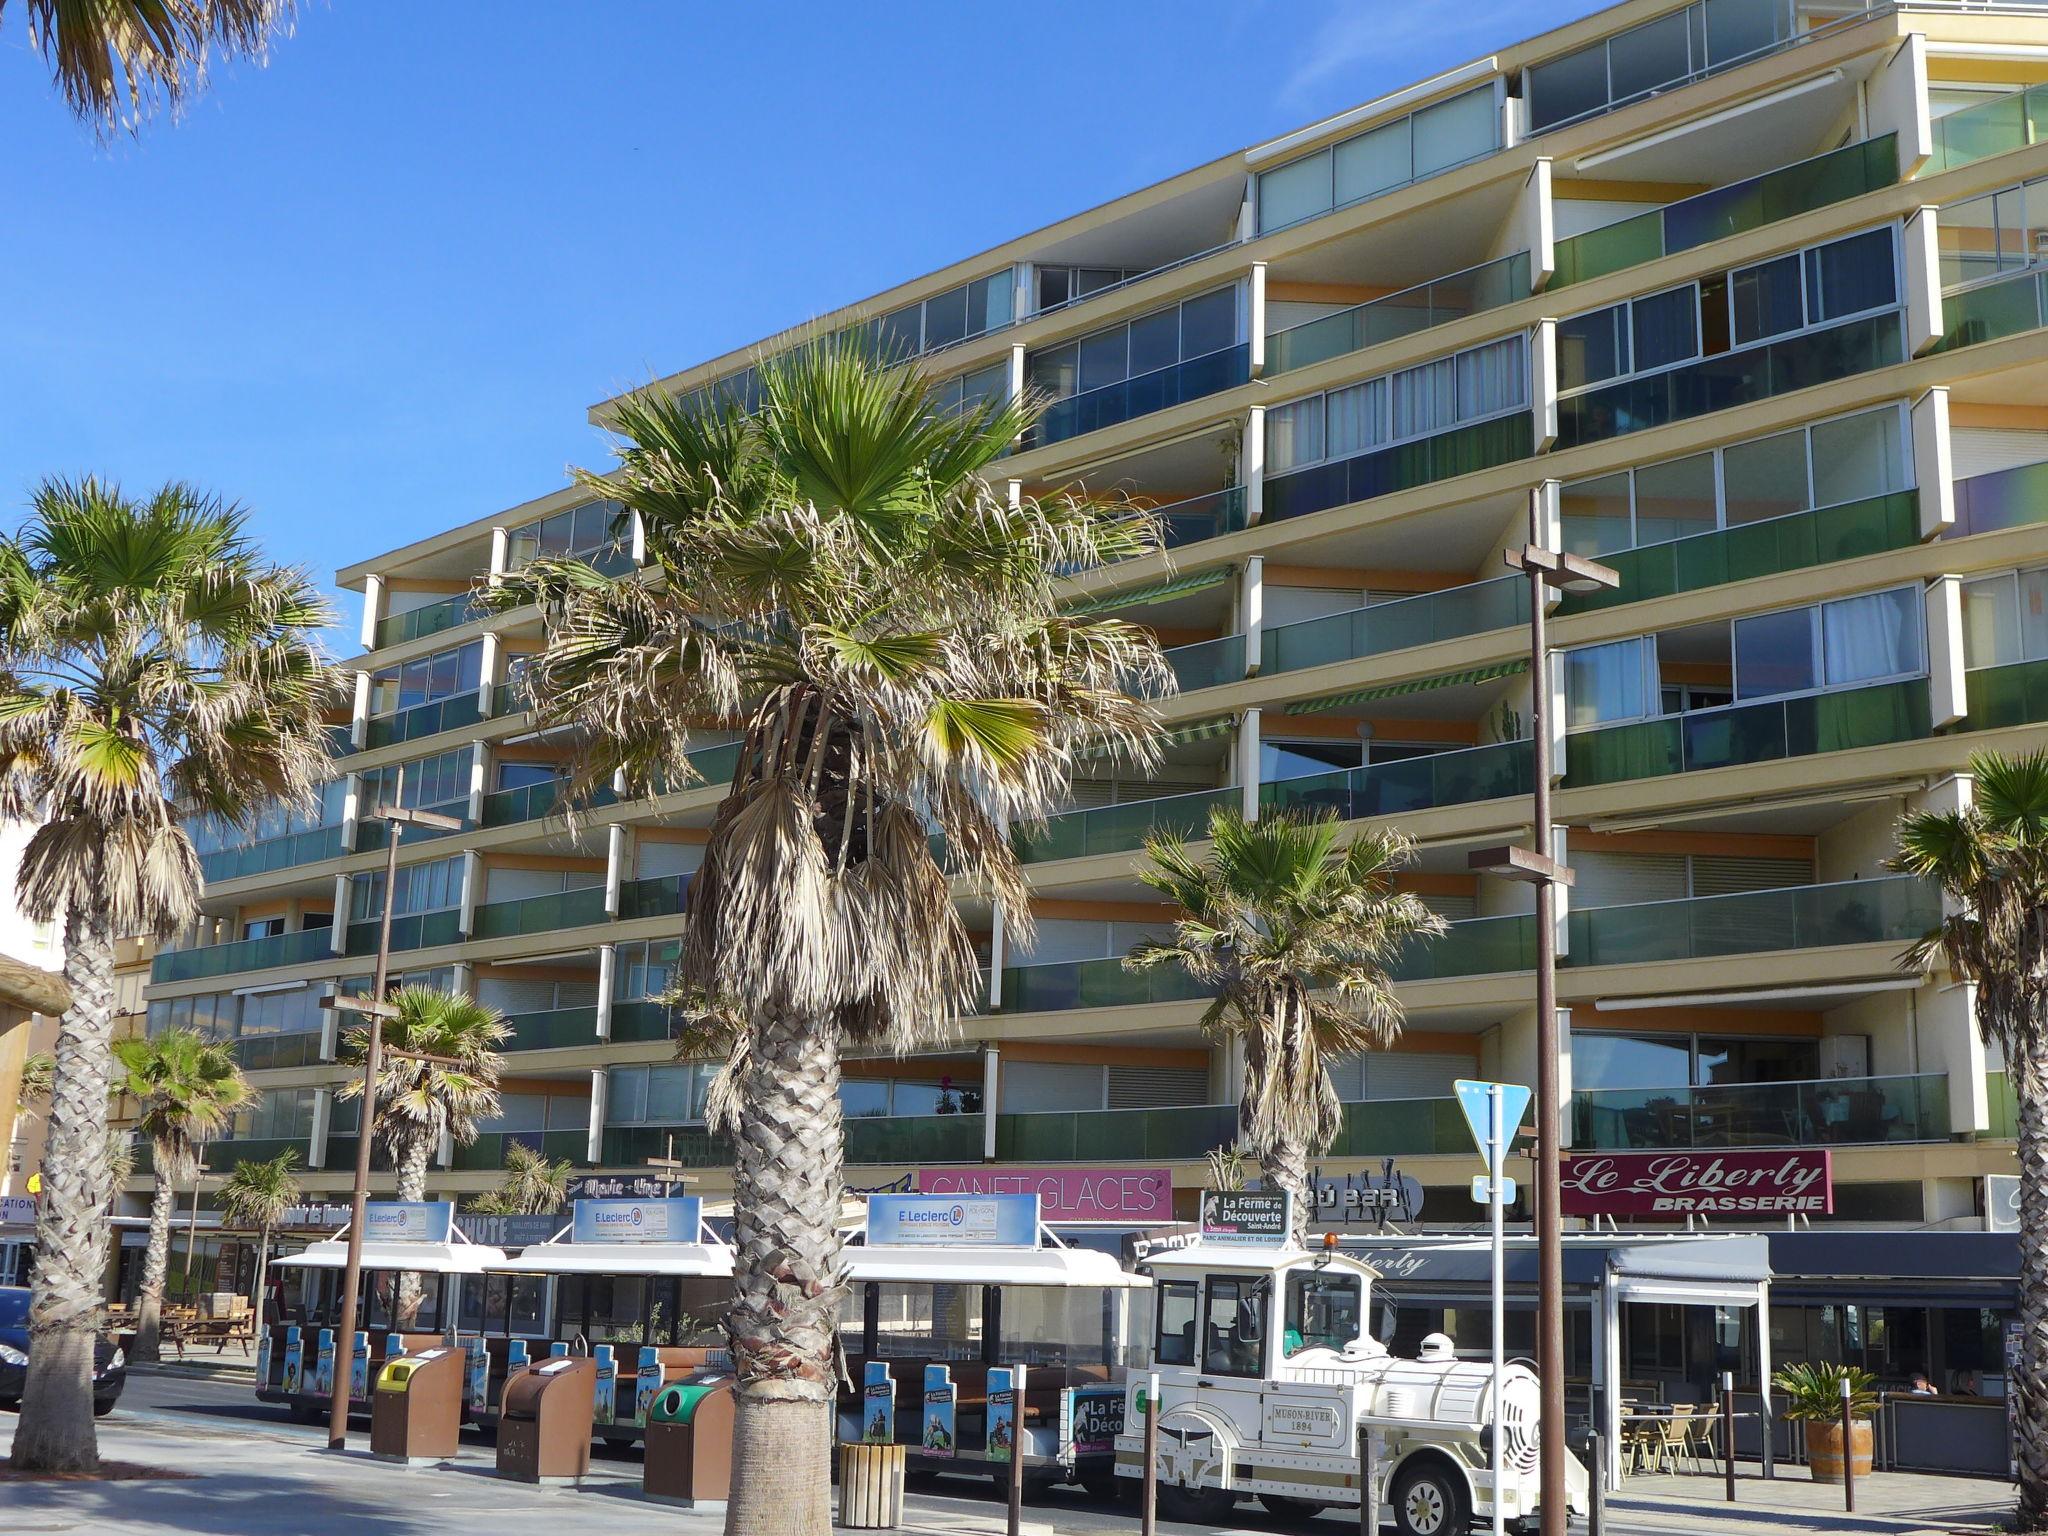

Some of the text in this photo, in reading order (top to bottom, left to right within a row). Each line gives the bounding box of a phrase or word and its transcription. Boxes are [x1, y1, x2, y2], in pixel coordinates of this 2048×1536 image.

[1634, 1156, 1824, 1196] Liberty
[1036, 1177, 1157, 1211] GLACES
[1223, 1197, 1235, 1209] La
[1238, 1197, 1271, 1209] Ferme
[1652, 1196, 1825, 1211] BRASSERIE
[1222, 1210, 1282, 1222] Découverte
[1090, 1400, 1106, 1415] La
[1291, 1421, 1312, 1432] 1894
